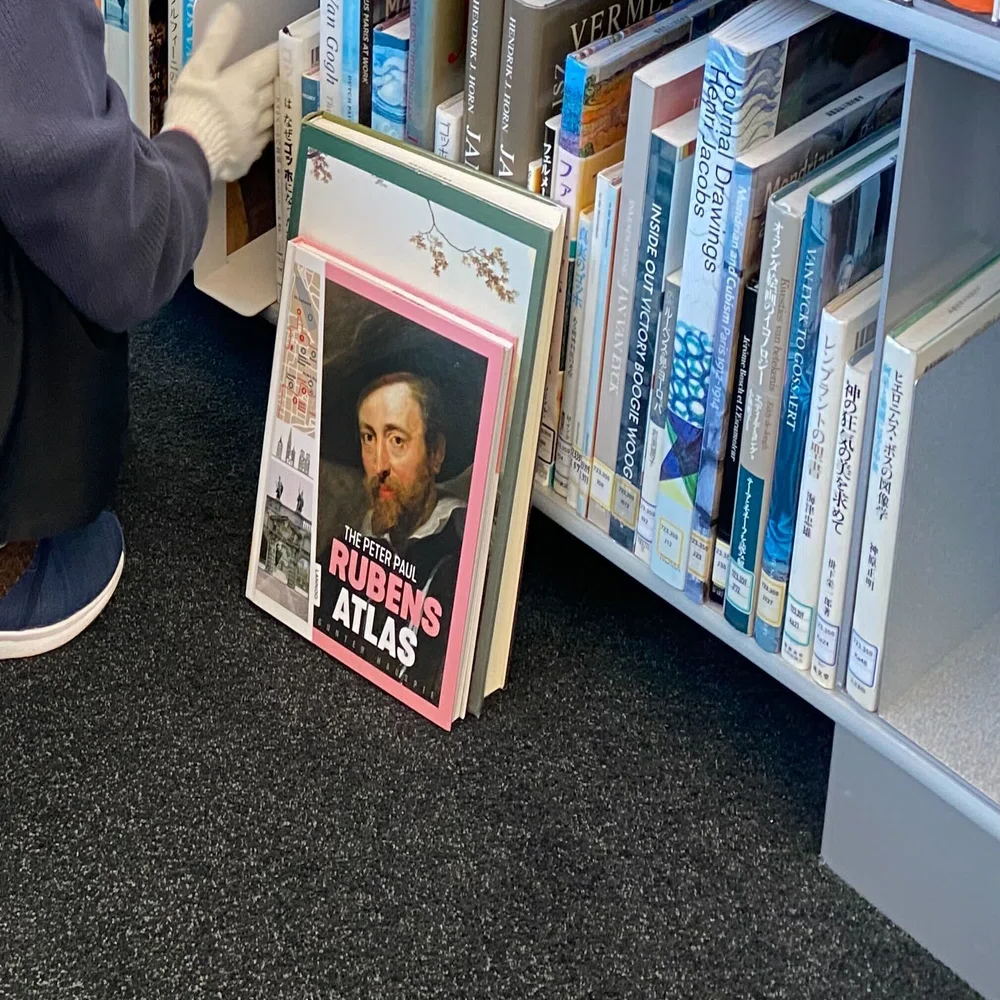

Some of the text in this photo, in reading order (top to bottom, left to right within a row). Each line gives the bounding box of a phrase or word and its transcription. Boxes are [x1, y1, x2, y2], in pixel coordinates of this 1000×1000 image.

[321, 35, 340, 86] Gogh
[361, 13, 370, 85] MARIS AT WORK
[466, 0, 480, 114] HENDRIK HORN
[501, 16, 517, 134] HENDRIK HORN
[693, 64, 728, 219] Henri Jacobs
[702, 71, 744, 274] Journal Drawings
[628, 202, 663, 427] INSIDE OUT VICTORY BOOGIE
[719, 186, 748, 356] Mondrian and Cubism Paris
[785, 249, 817, 432] VAN EYCK TO GOSSAERT
[328, 537, 443, 638] RUBENS
[344, 525, 417, 584] THE PETER PAUL
[331, 586, 418, 668] ATLAS
